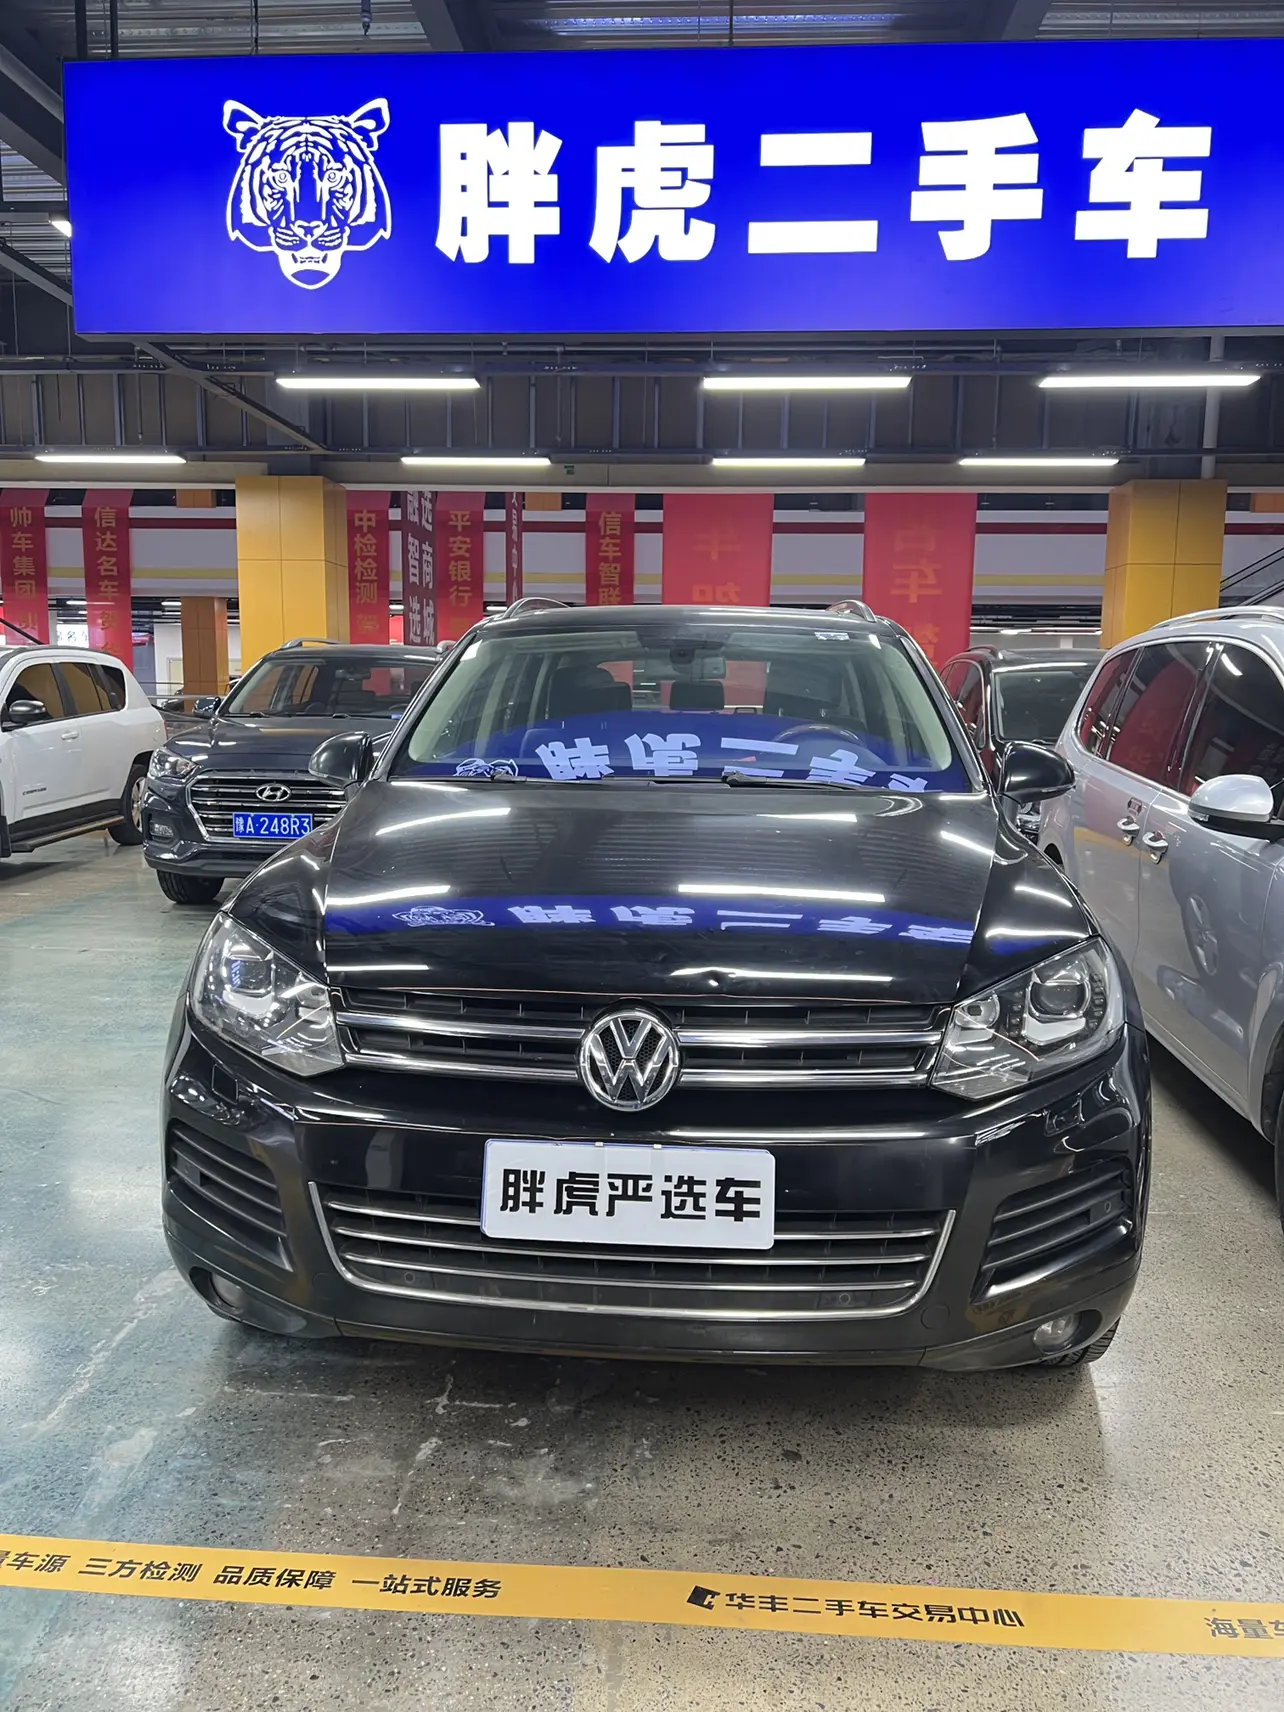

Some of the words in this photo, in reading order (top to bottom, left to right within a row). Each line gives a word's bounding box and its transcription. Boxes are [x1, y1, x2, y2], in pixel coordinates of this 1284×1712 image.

[434, 108, 1212, 264] 胖虎二手车
[9, 506, 36, 598] 帅车集团
[94, 506, 120, 600] 信达名车
[353, 509, 379, 604] 中检检测
[448, 510, 473, 607] 平安银行
[500, 1168, 761, 1222] 胖虎严选车
[78, 1556, 203, 1583] 三方检测
[212, 1564, 337, 1591] 品质保障
[351, 1573, 502, 1599] 一站式服务
[725, 1592, 1025, 1628] 华丰二手车交易中心
